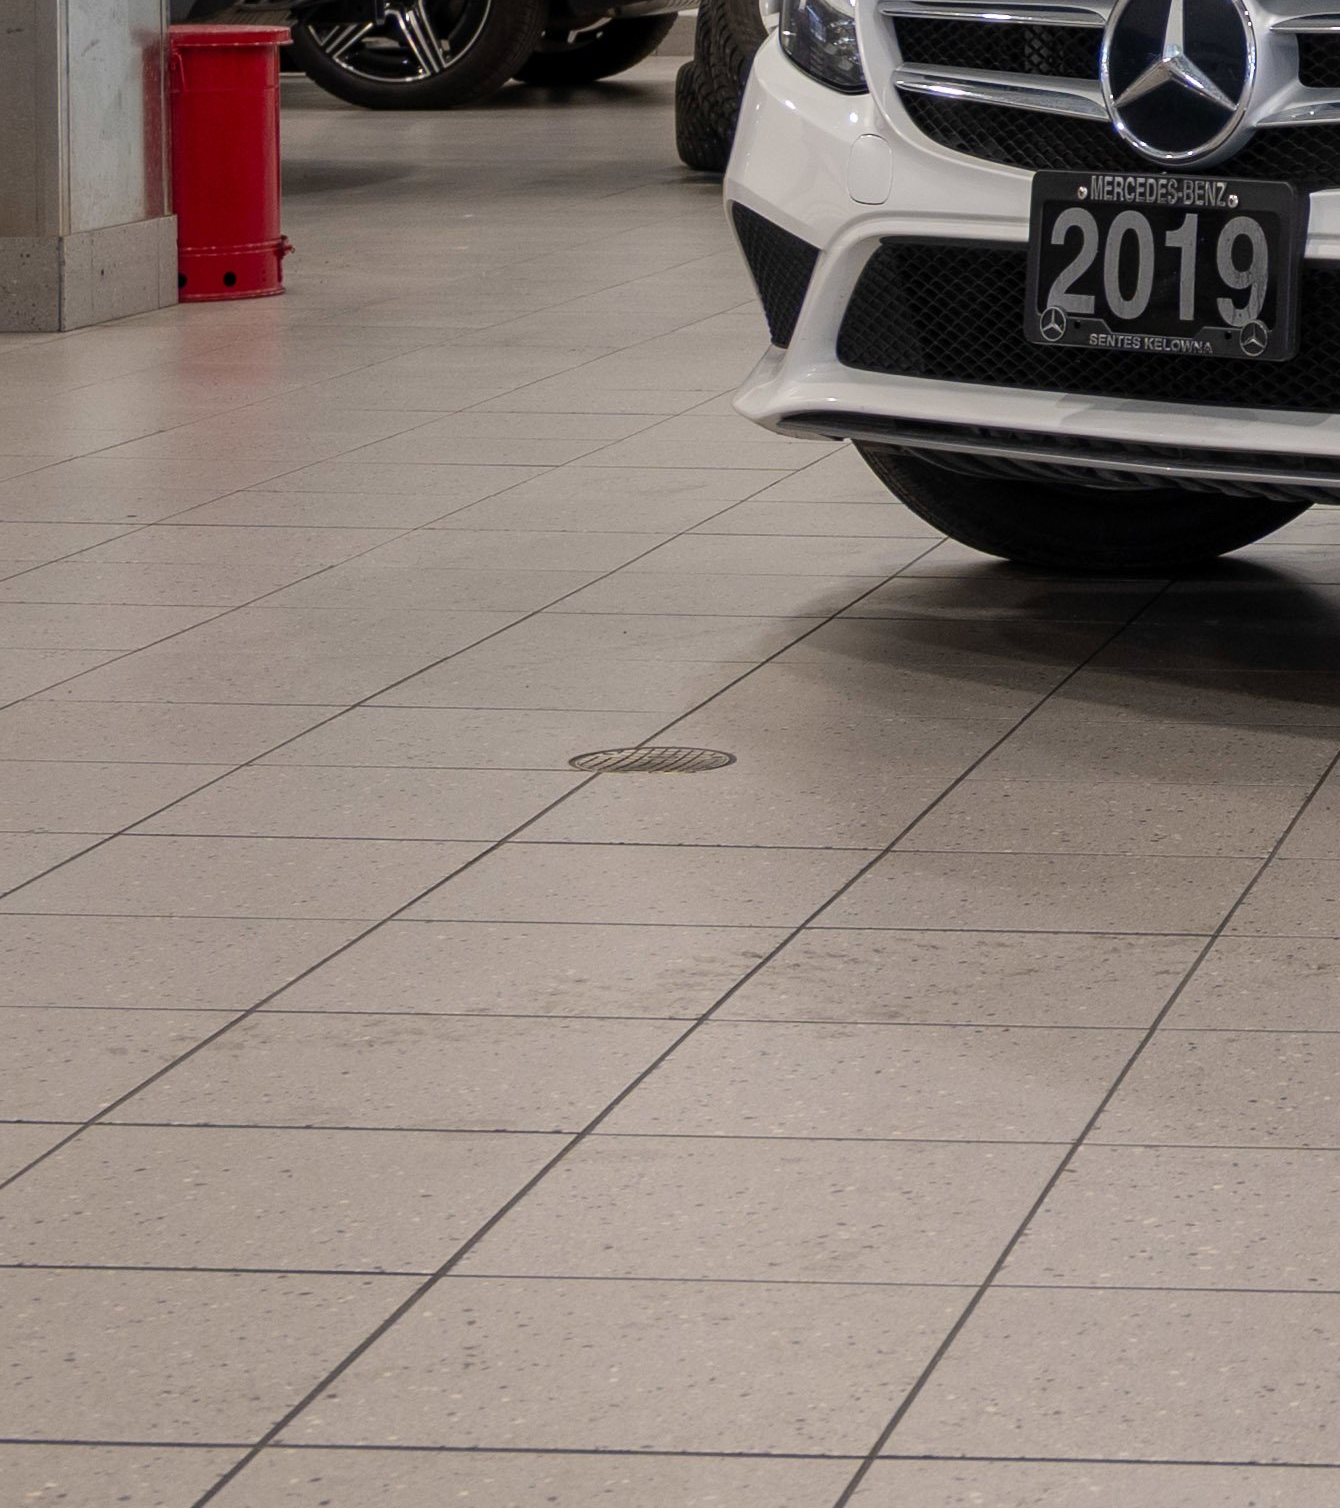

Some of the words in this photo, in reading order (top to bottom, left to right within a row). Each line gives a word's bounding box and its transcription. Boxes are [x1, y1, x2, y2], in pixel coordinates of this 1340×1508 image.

[1090, 175, 1228, 207] MERCEDES-BENZ
[1046, 207, 1269, 327] 2019
[1089, 333, 1141, 349] SENTES
[1144, 337, 1213, 354] KELOWNA
